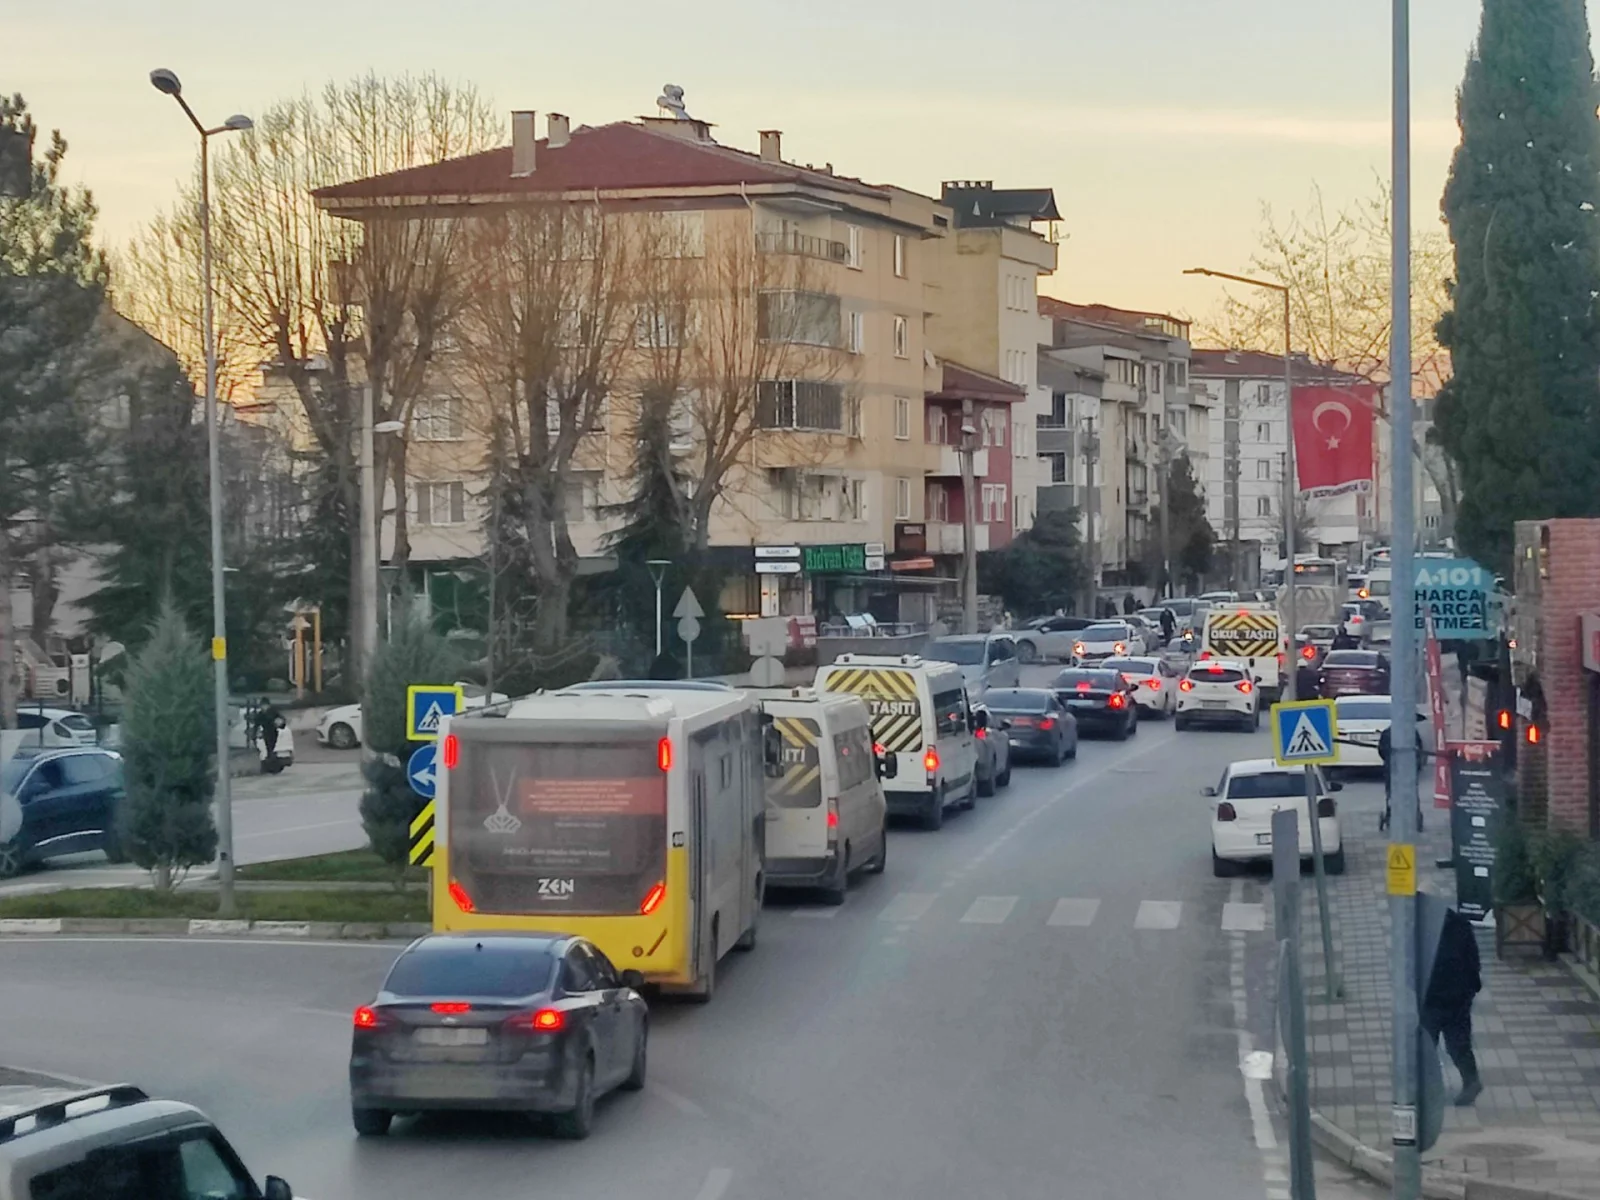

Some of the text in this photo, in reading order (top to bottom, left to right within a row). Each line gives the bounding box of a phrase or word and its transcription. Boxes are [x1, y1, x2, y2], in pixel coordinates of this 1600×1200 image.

[1414, 589, 1481, 601] HARCA
[1414, 603, 1481, 616] HARCA
[1414, 617, 1482, 629] BTMEZ
[1211, 629, 1239, 640] OKUL
[870, 701, 916, 716] TAŞITI
[537, 878, 575, 894] ZEN
